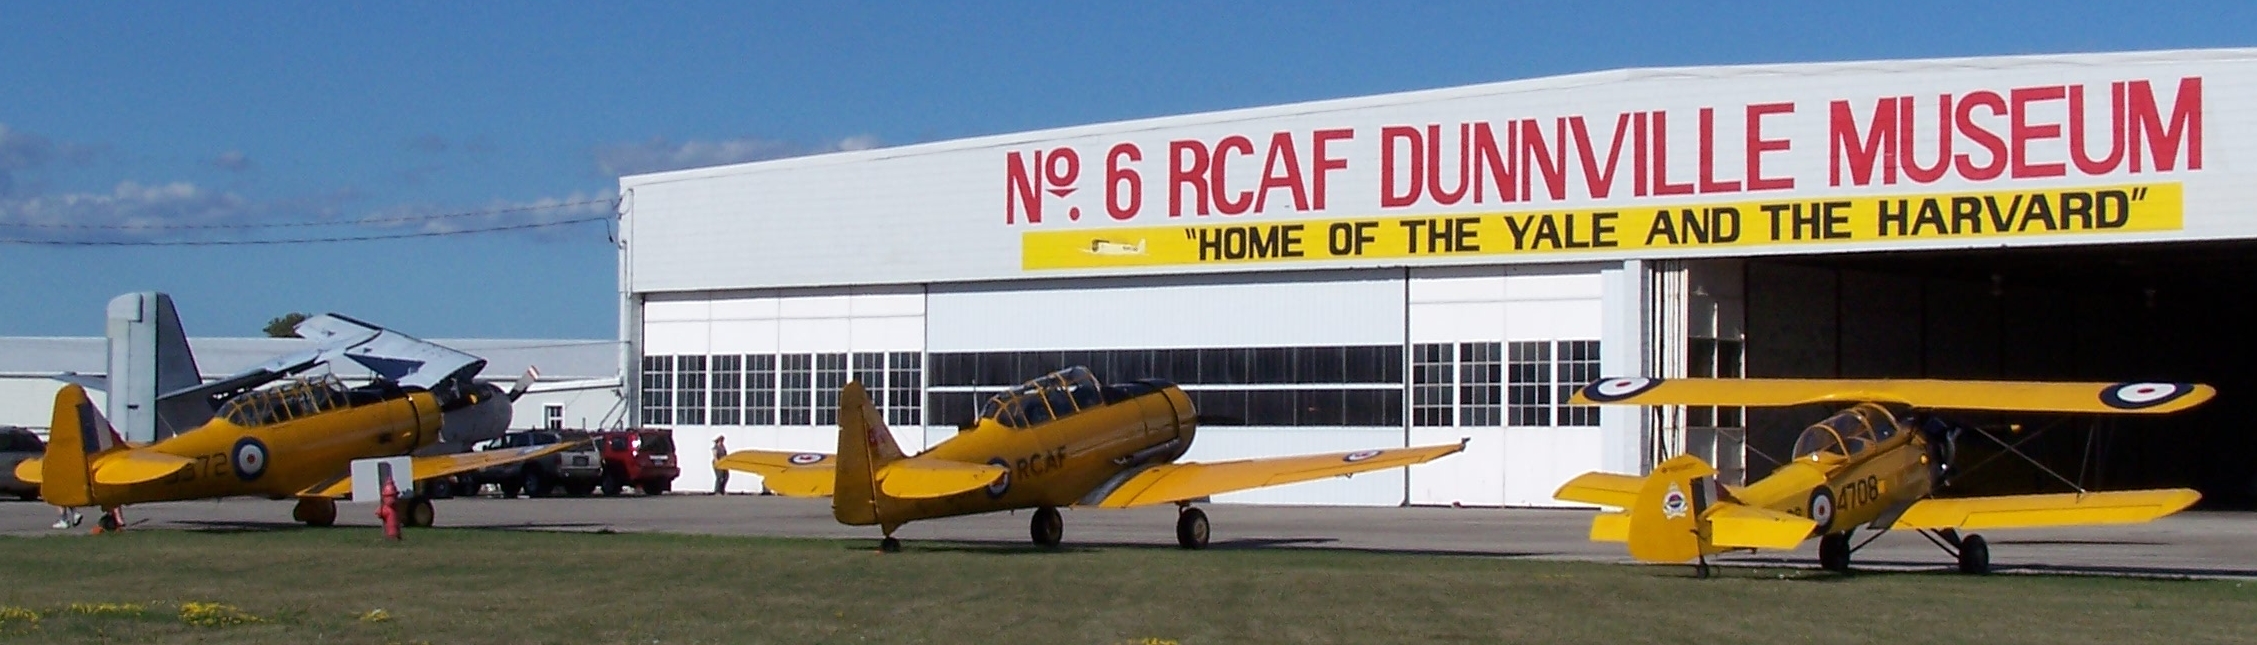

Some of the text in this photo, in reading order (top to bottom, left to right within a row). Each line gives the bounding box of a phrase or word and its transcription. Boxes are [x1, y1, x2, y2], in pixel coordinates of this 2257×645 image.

[1106, 143, 1142, 221] 6
[1169, 129, 1354, 217] RCAF
[1381, 102, 1795, 208] DUNNVILLE
[1829, 77, 2202, 187] MUSEUM
[1185, 187, 2147, 261] "HOME OF THE YALE AND THE HARVARD"
[1017, 445, 1066, 480] RCAF
[1837, 475, 1879, 510] 4708
